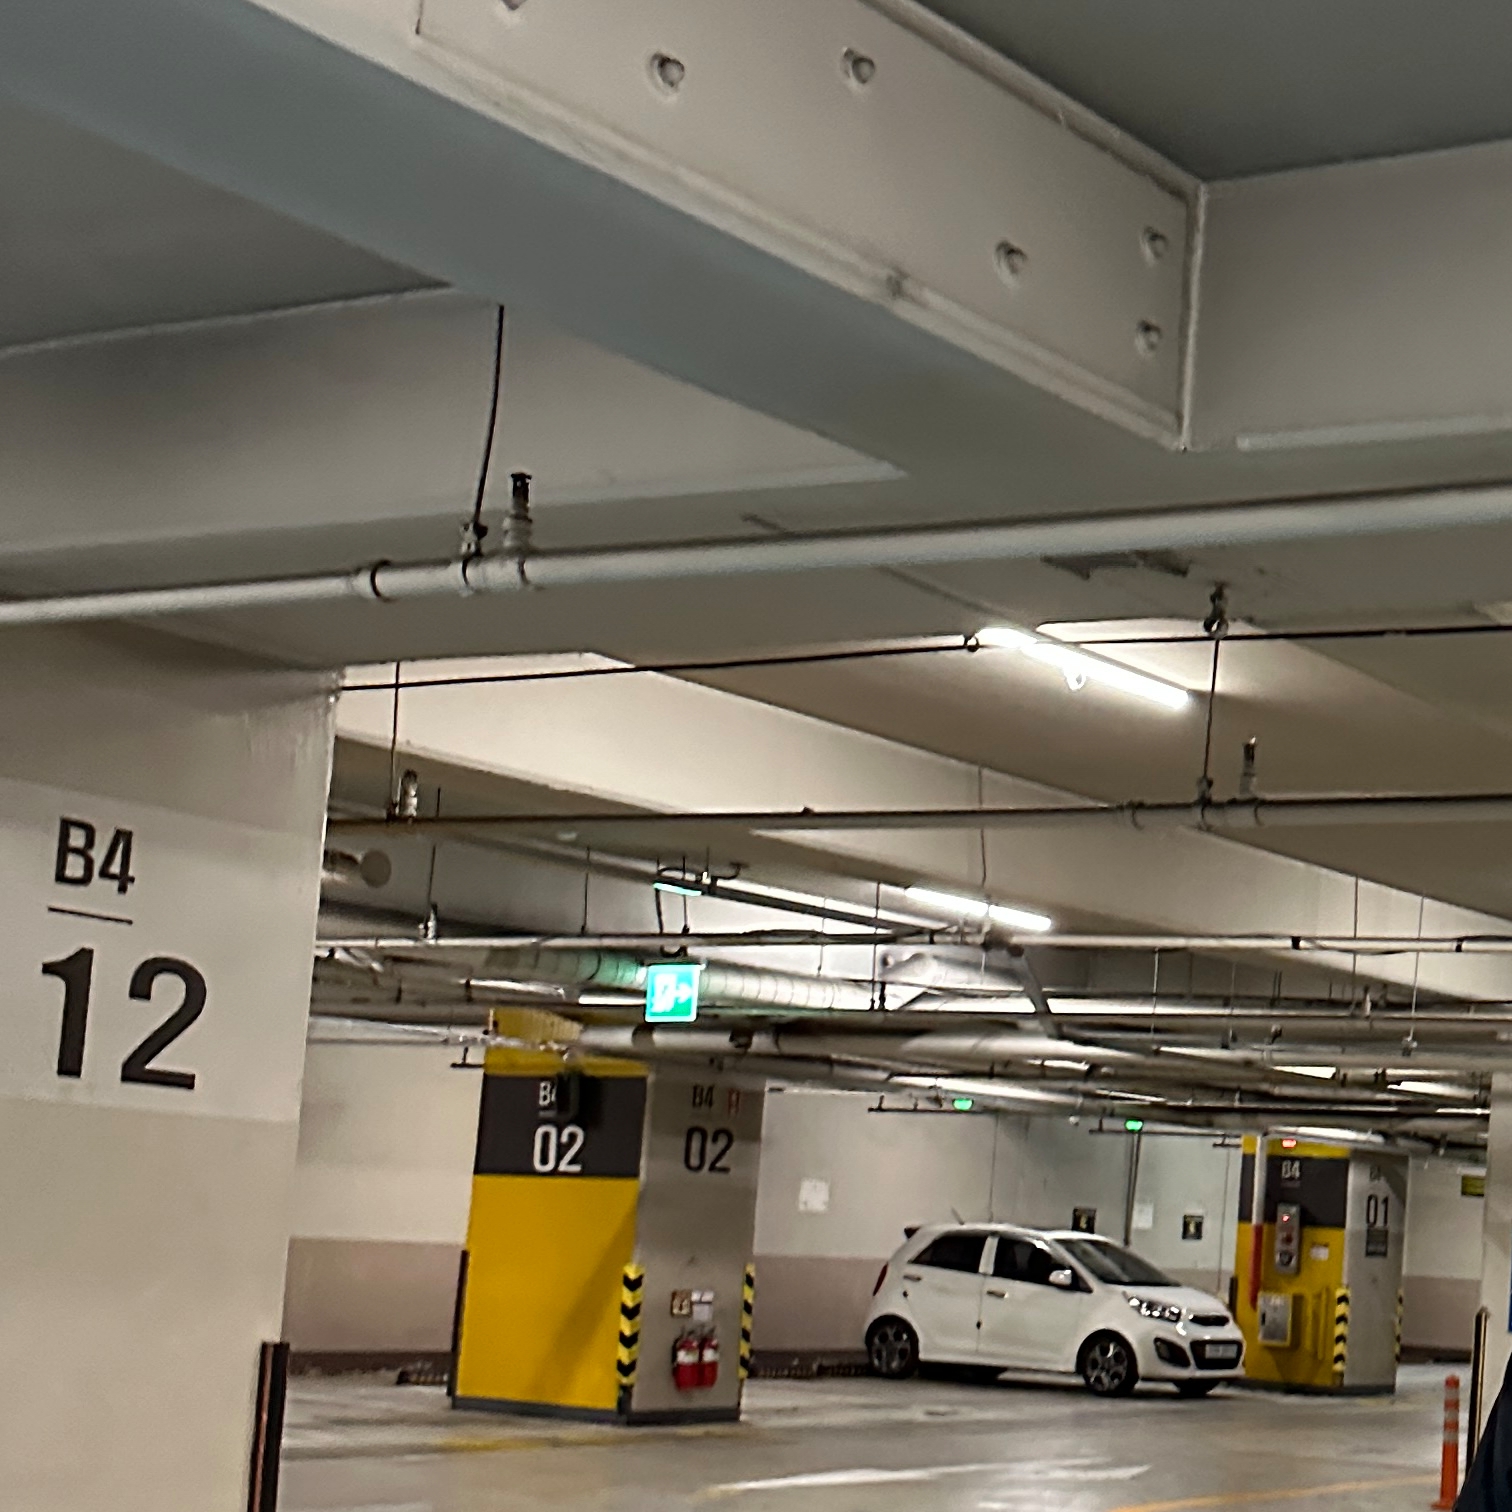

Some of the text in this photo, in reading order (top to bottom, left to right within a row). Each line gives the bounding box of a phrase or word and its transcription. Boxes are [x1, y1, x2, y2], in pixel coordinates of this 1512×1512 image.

[54, 815, 136, 895] B4
[41, 946, 208, 1090] 12
[692, 1083, 715, 1109] B4
[532, 1123, 586, 1173] 02
[684, 1125, 735, 1174] 02
[1366, 1194, 1390, 1228] 01
